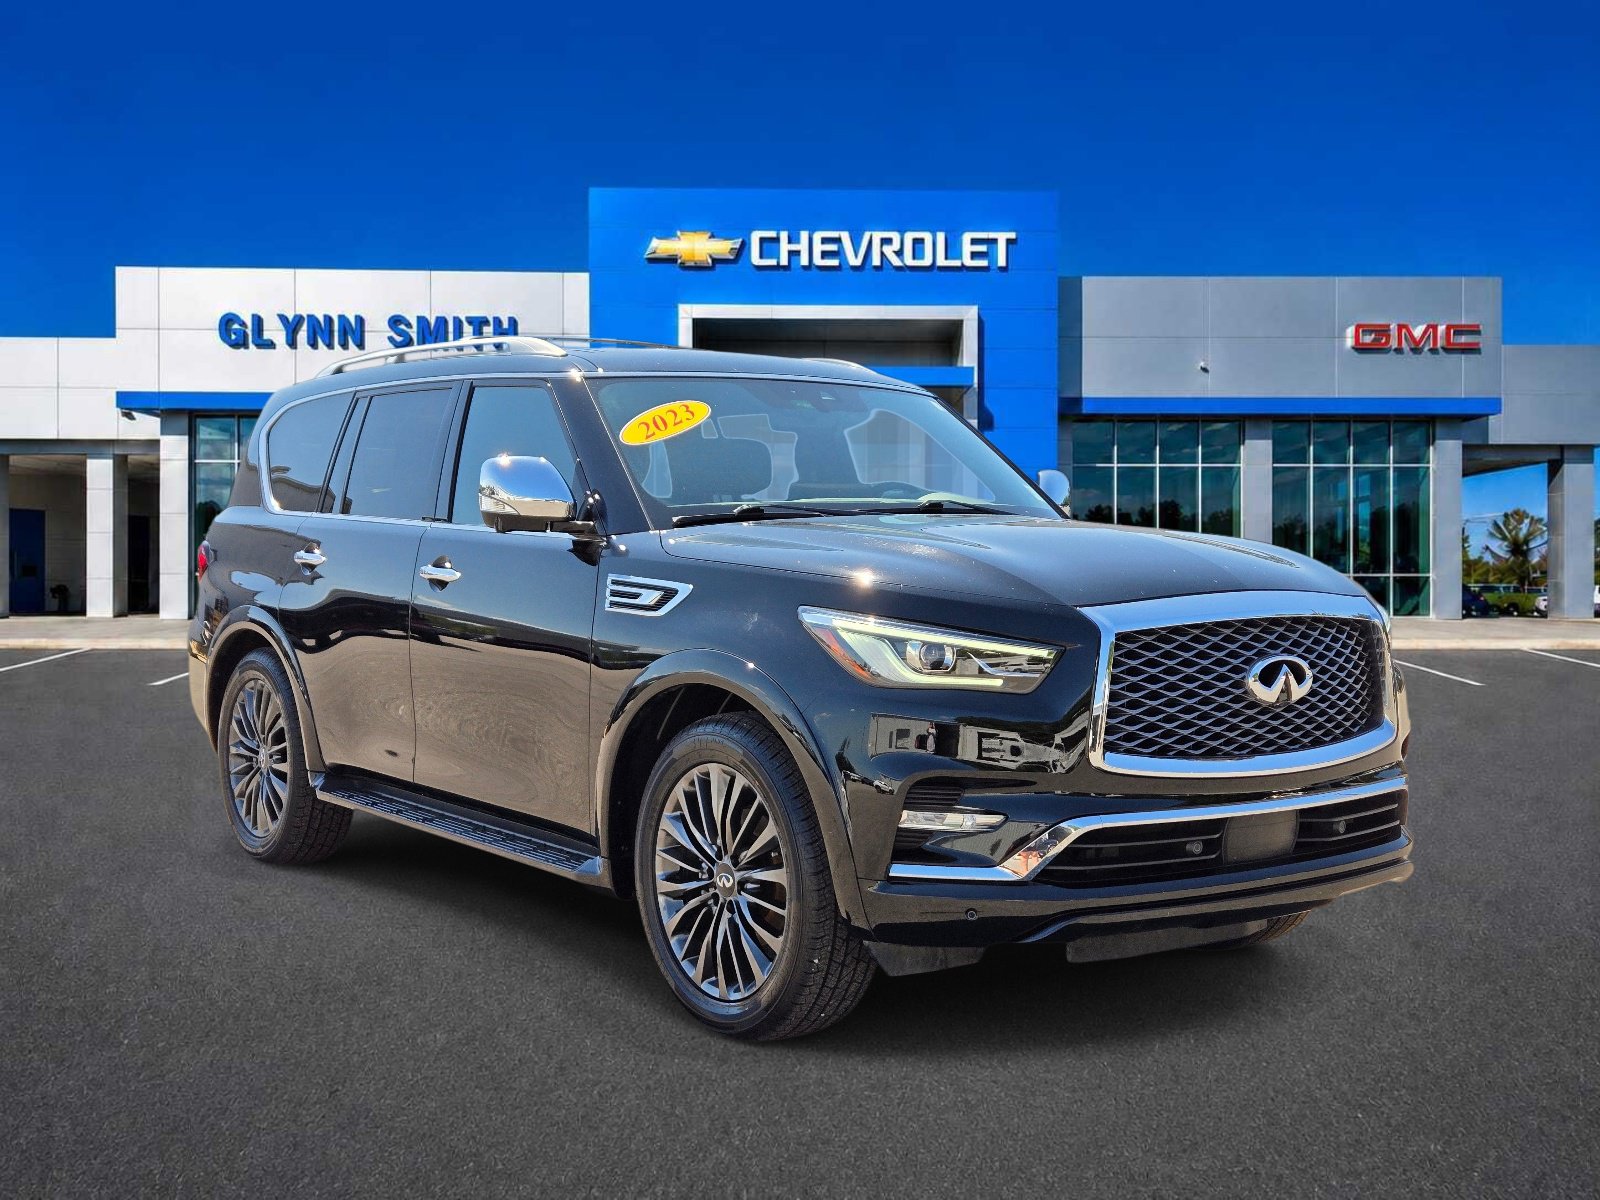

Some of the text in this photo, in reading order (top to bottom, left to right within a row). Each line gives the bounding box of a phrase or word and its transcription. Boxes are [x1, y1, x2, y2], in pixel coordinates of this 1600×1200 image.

[750, 230, 1017, 268] CHEVROLET
[218, 312, 519, 350] GLYNN SMITH
[1349, 322, 1482, 352] GMC
[637, 403, 696, 440] 2023
